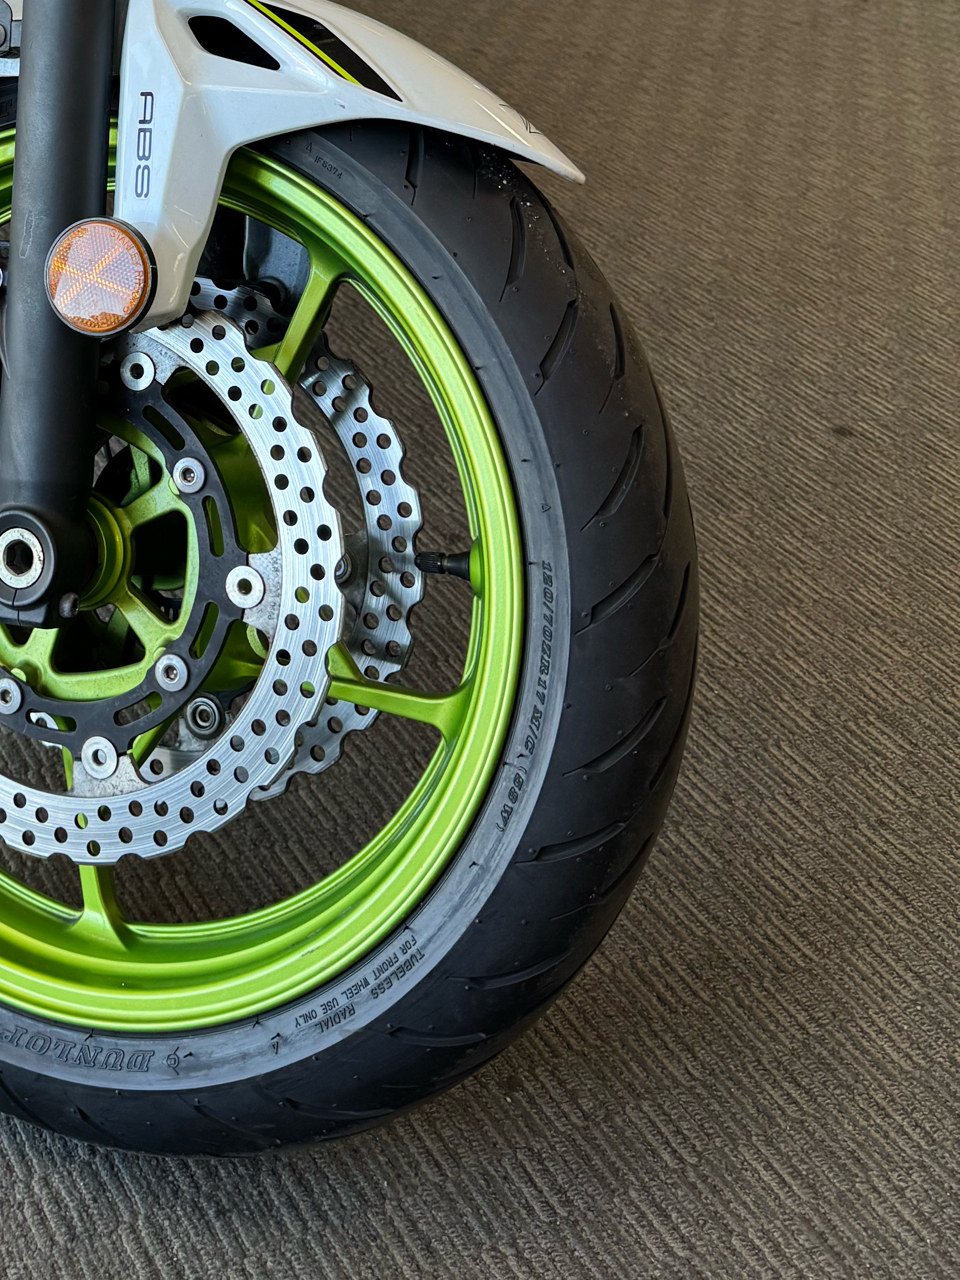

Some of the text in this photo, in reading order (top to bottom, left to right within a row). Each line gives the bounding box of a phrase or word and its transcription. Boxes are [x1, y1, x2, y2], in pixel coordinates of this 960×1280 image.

[135, 91, 155, 199] ABS
[294, 934, 418, 1029] FOR FRONT WHEEL USE ONLY
[314, 947, 426, 1034] TUBELESS RADIAL
